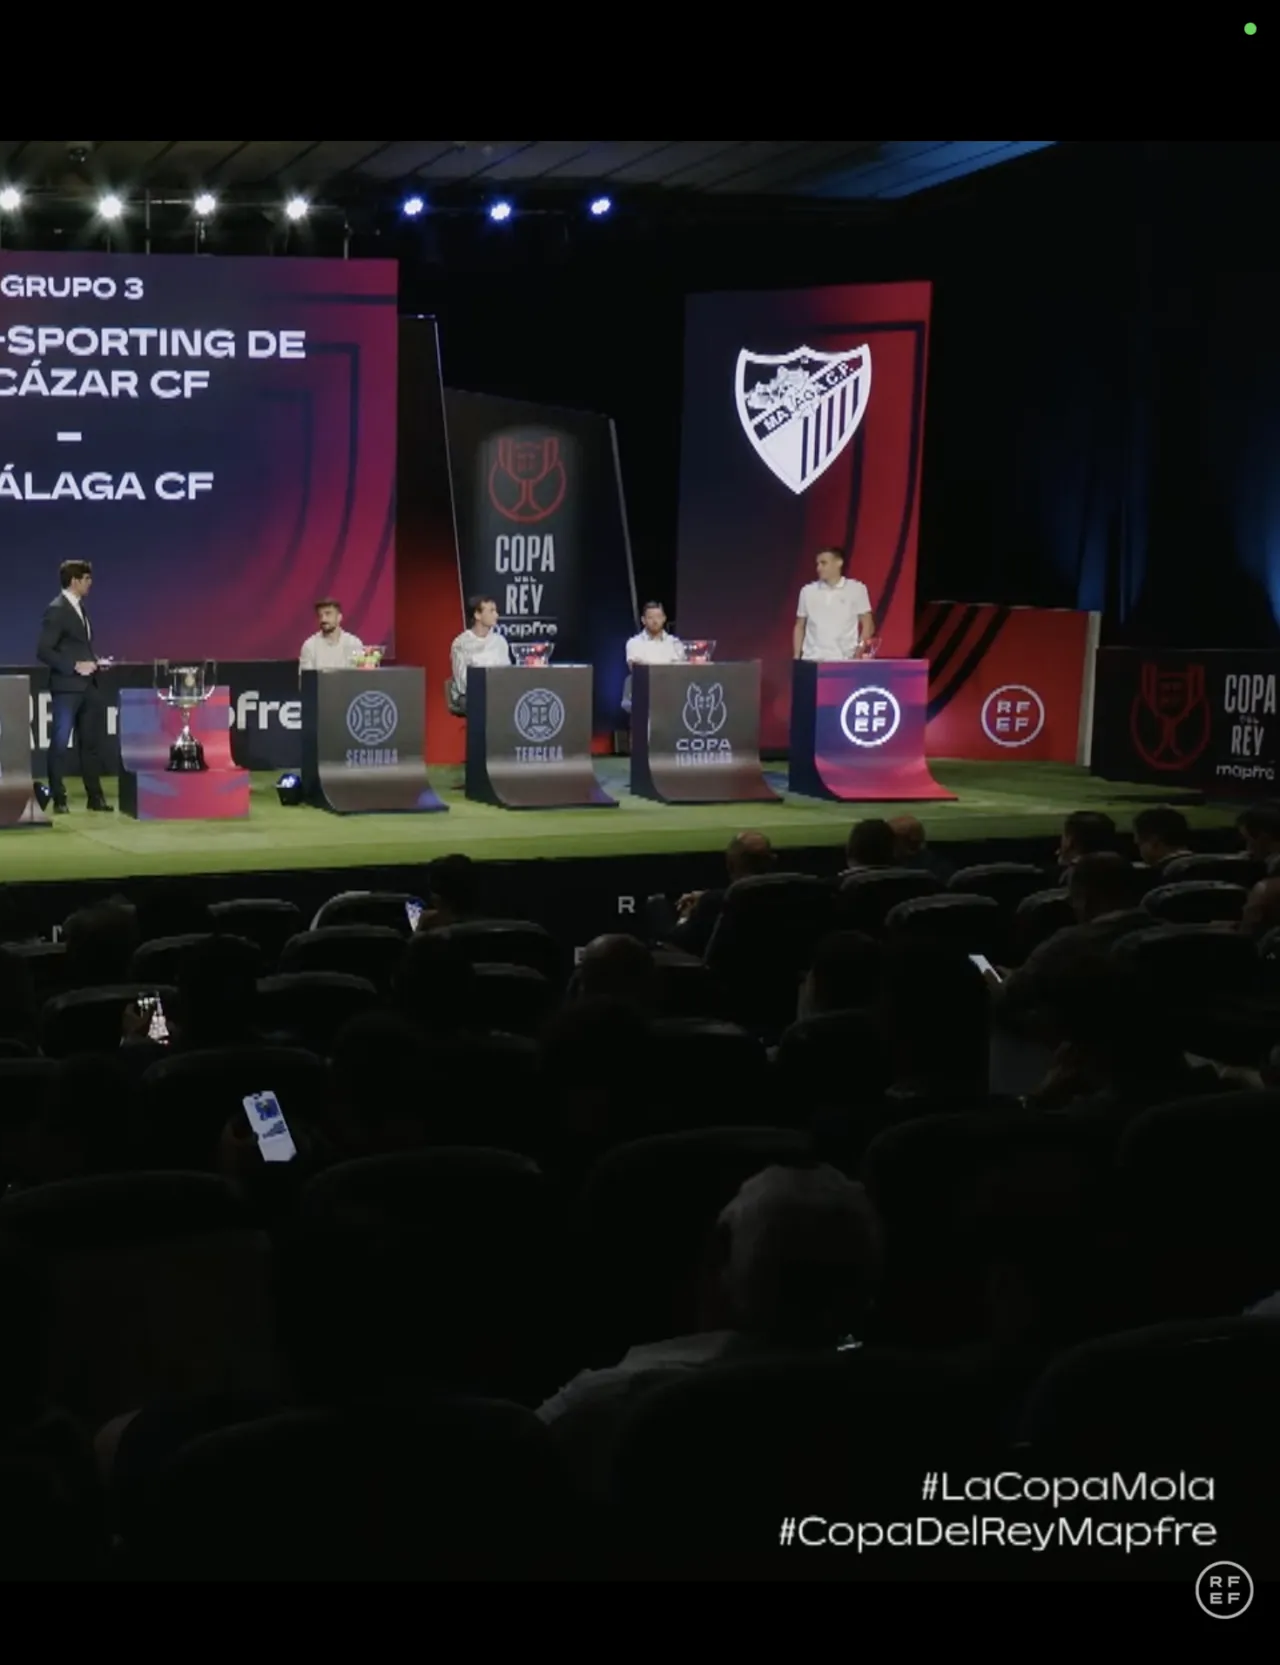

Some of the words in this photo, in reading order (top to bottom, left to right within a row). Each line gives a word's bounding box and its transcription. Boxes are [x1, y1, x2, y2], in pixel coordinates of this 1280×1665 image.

[0, 274, 117, 299] GRUPO
[123, 277, 144, 300] 3
[248, 330, 306, 359] DE
[150, 370, 210, 399] CF
[154, 471, 214, 500] CF
[495, 534, 555, 574] COPA
[505, 583, 544, 615] REY
[855, 701, 887, 716] RF
[996, 701, 1031, 713] RF
[1224, 674, 1276, 714] COPA
[854, 717, 886, 732] EF
[995, 717, 1029, 732] EF
[676, 738, 731, 751] COPA
[1231, 725, 1265, 756] REY
